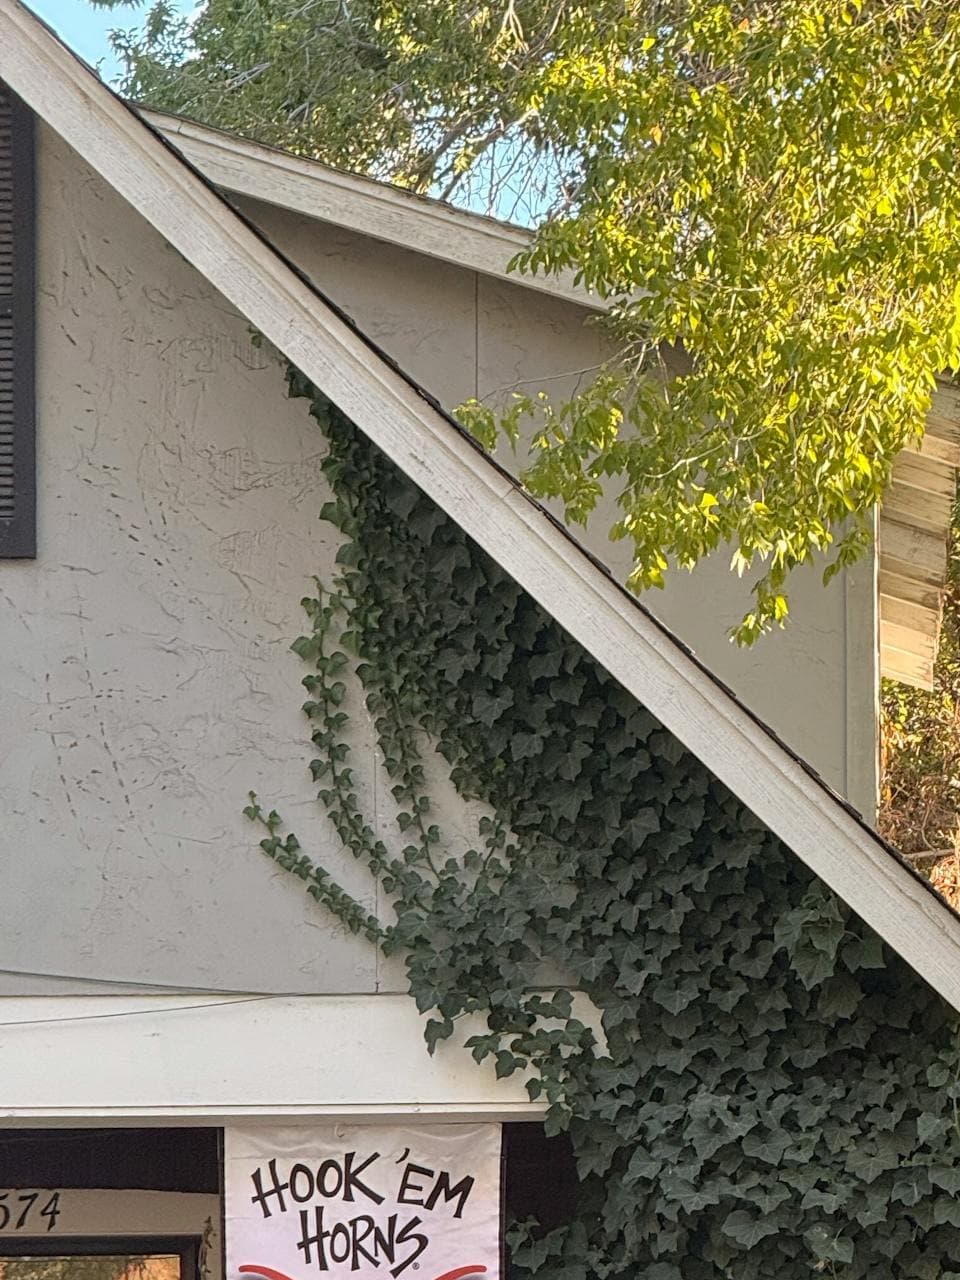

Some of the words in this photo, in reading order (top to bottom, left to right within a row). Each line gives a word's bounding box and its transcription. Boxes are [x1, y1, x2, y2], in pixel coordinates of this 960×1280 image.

[251, 1151, 385, 1218] HOOK
[395, 1147, 475, 1219] 'EM
[297, 1206, 428, 1279] HORNS
